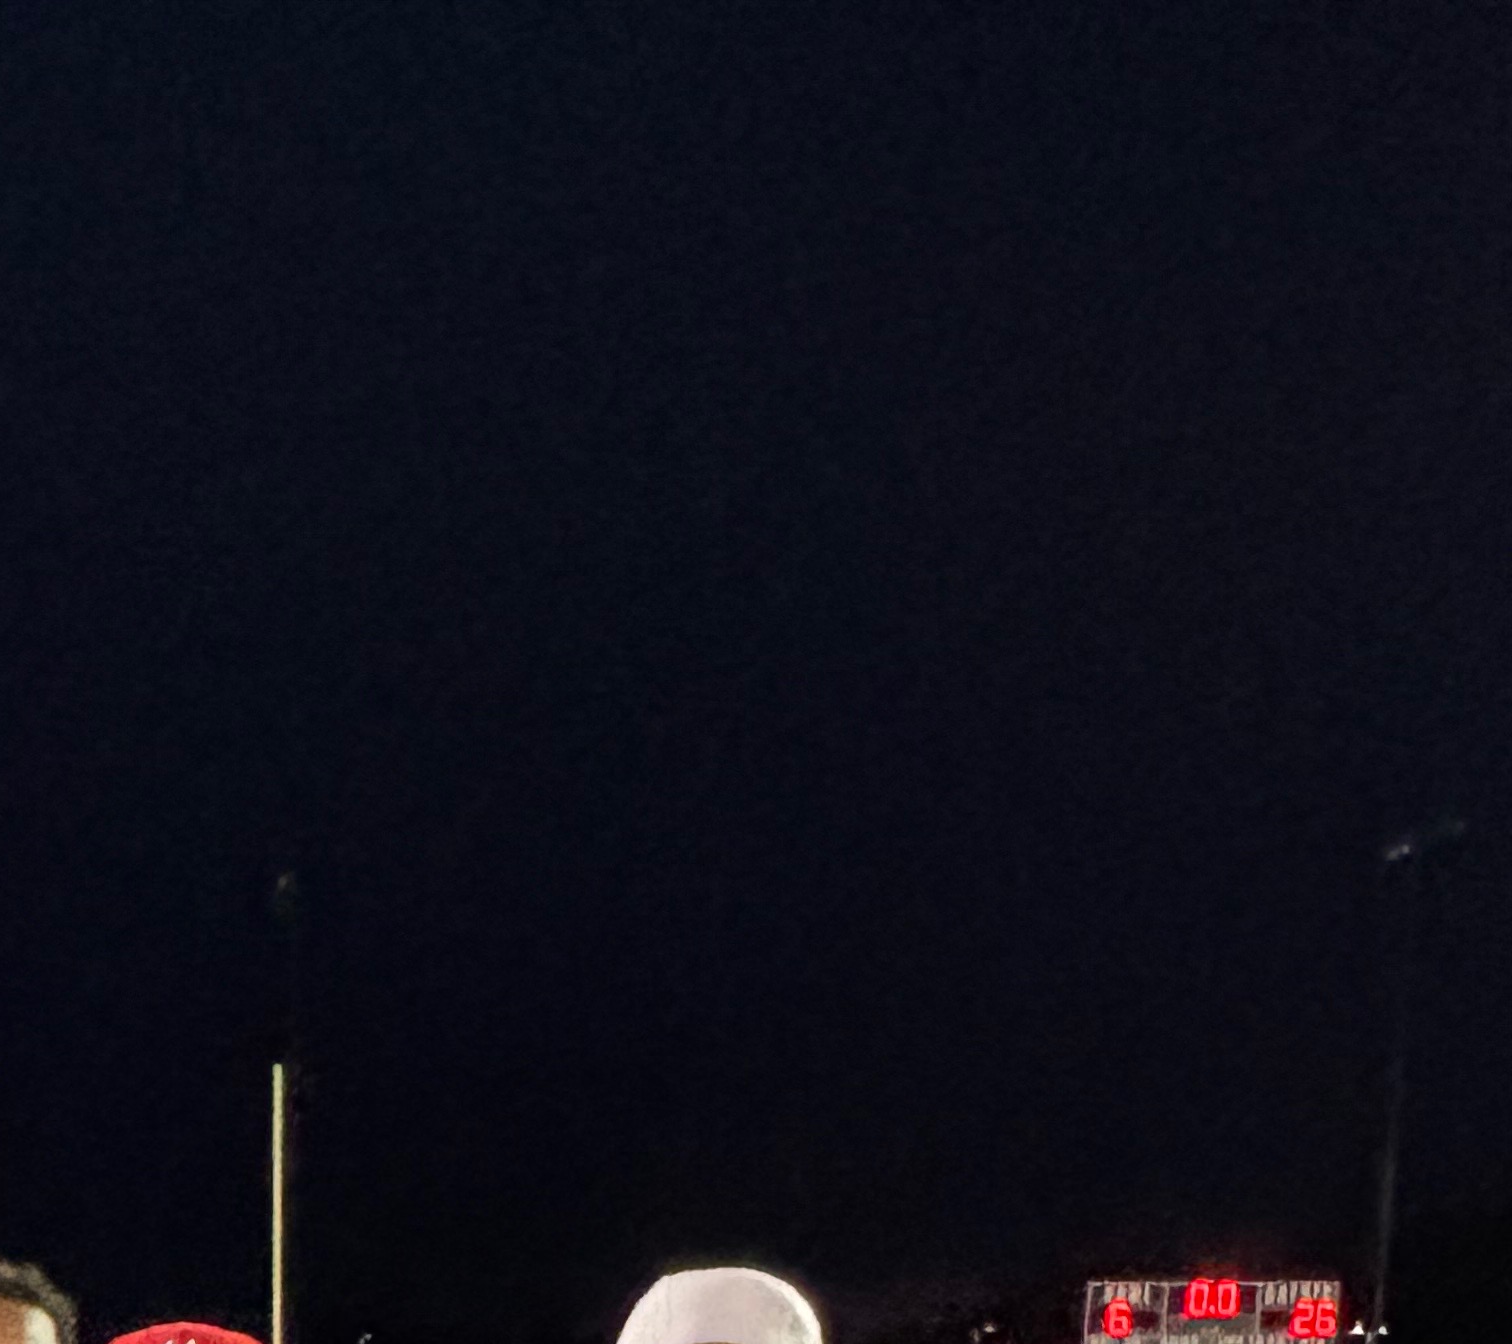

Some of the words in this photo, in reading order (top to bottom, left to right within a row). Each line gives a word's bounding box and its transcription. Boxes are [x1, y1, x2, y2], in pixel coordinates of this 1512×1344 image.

[1103, 1298, 1132, 1338] 6
[1183, 1279, 1240, 1319] 0.0
[1289, 1298, 1336, 1338] 26
